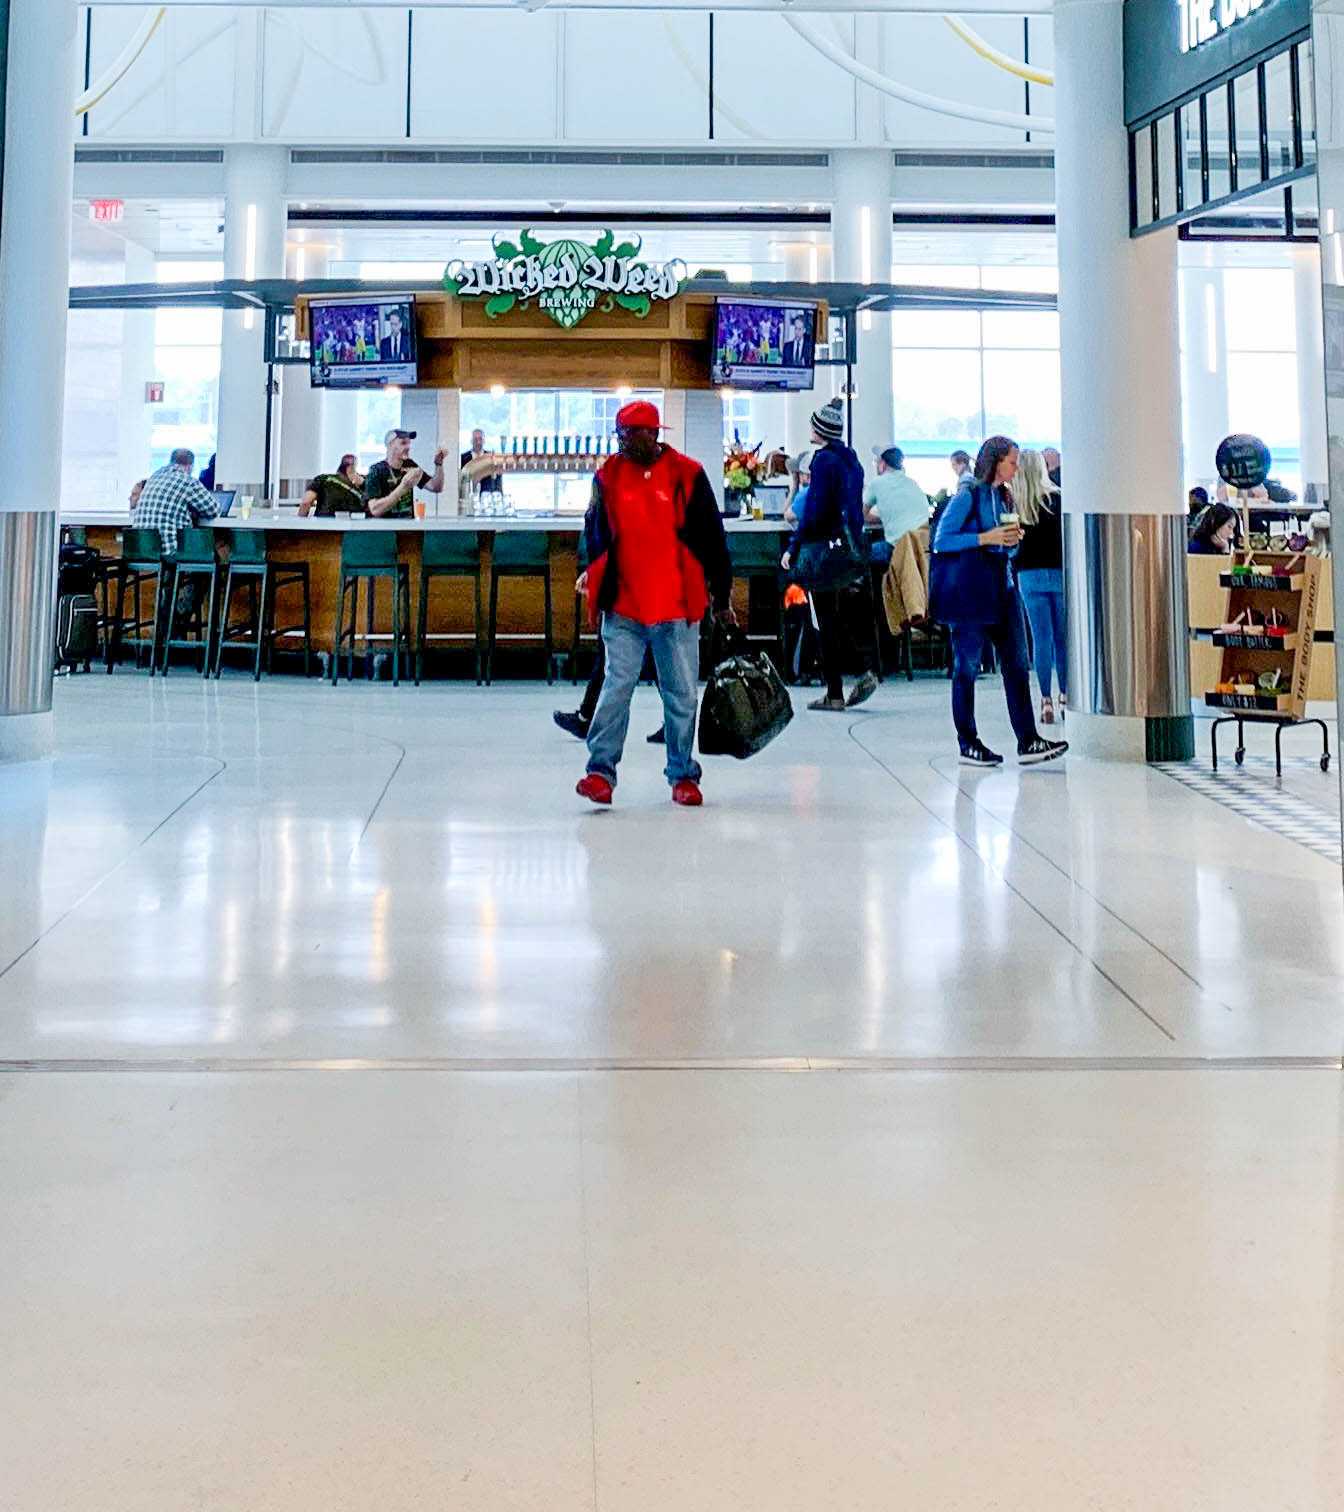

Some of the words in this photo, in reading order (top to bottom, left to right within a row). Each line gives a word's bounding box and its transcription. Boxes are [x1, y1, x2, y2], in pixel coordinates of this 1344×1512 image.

[457, 252, 578, 301] Wicked
[581, 254, 680, 301] Weed
[539, 297, 595, 308] BREWING
[1306, 575, 1316, 618] SHOP
[1301, 622, 1312, 666] BODY
[1296, 672, 1306, 701] THE
